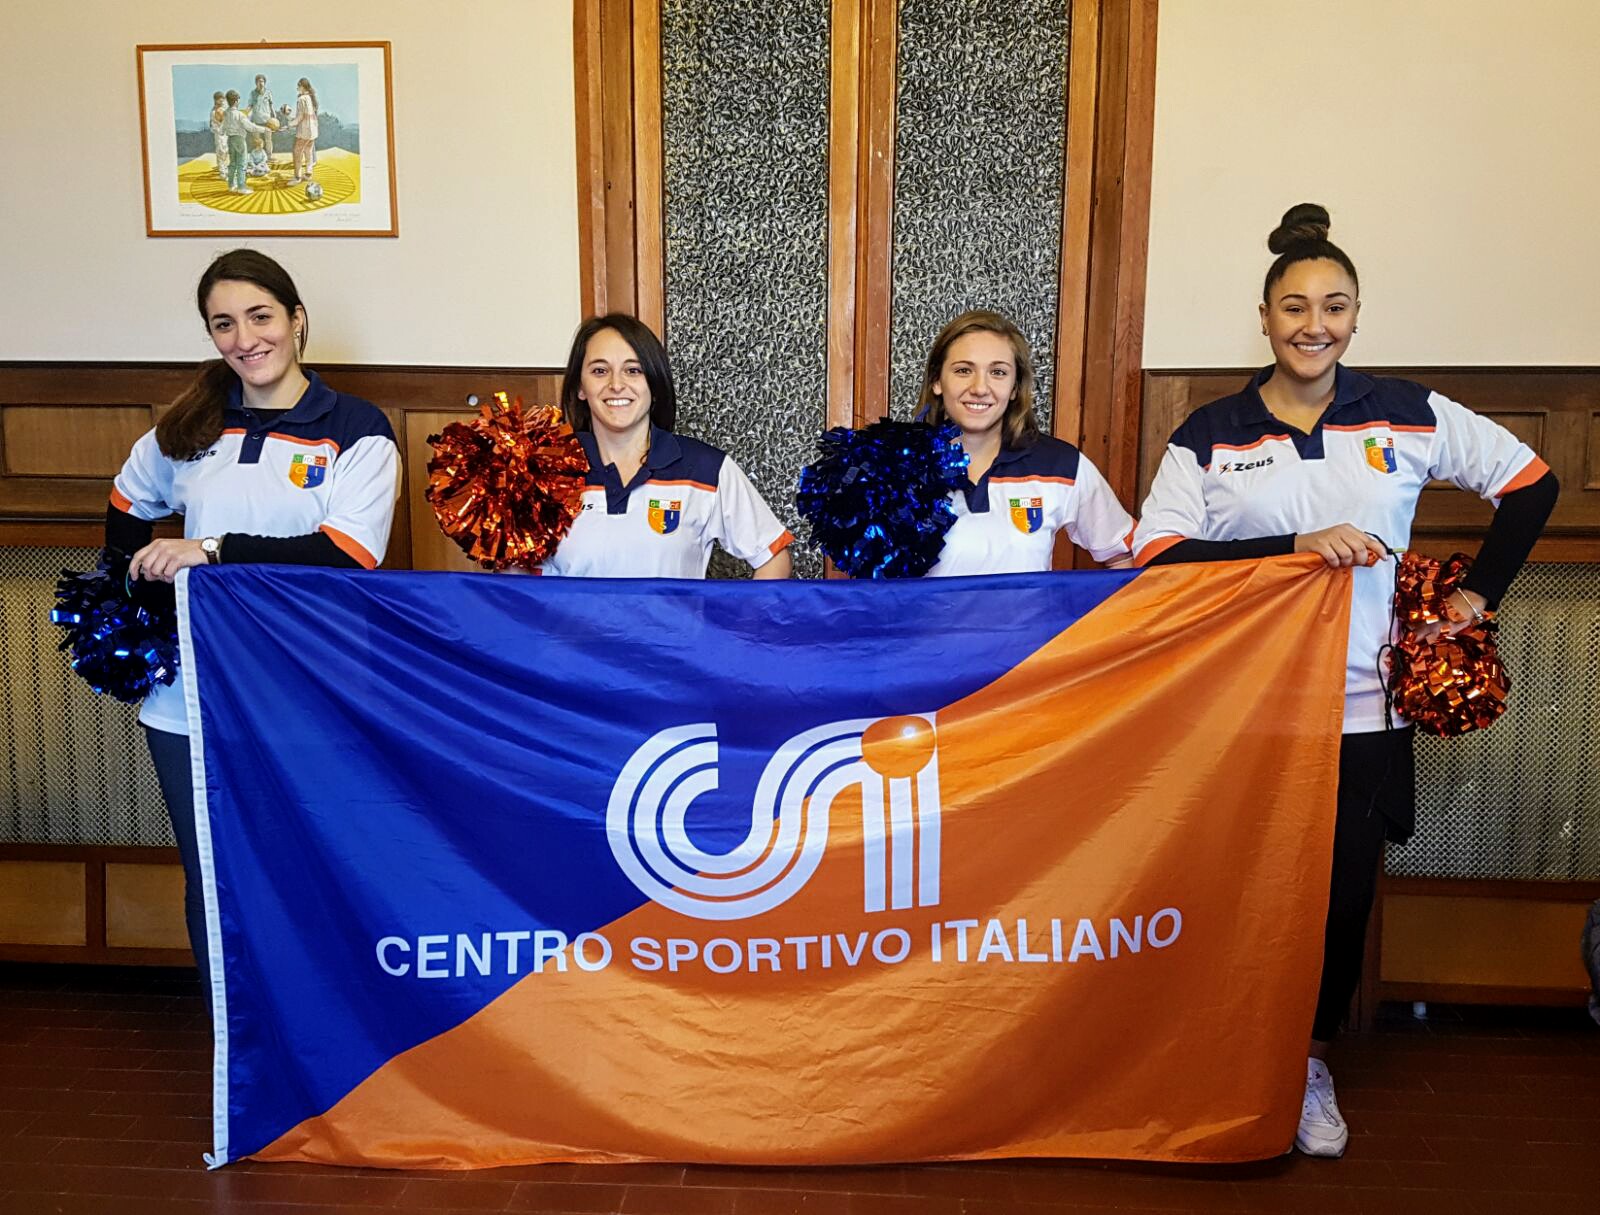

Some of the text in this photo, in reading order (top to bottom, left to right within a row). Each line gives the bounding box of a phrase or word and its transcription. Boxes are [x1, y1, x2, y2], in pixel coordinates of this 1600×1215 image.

[376, 907, 1182, 978] CENTRO SPORTIVO ITALIANO
